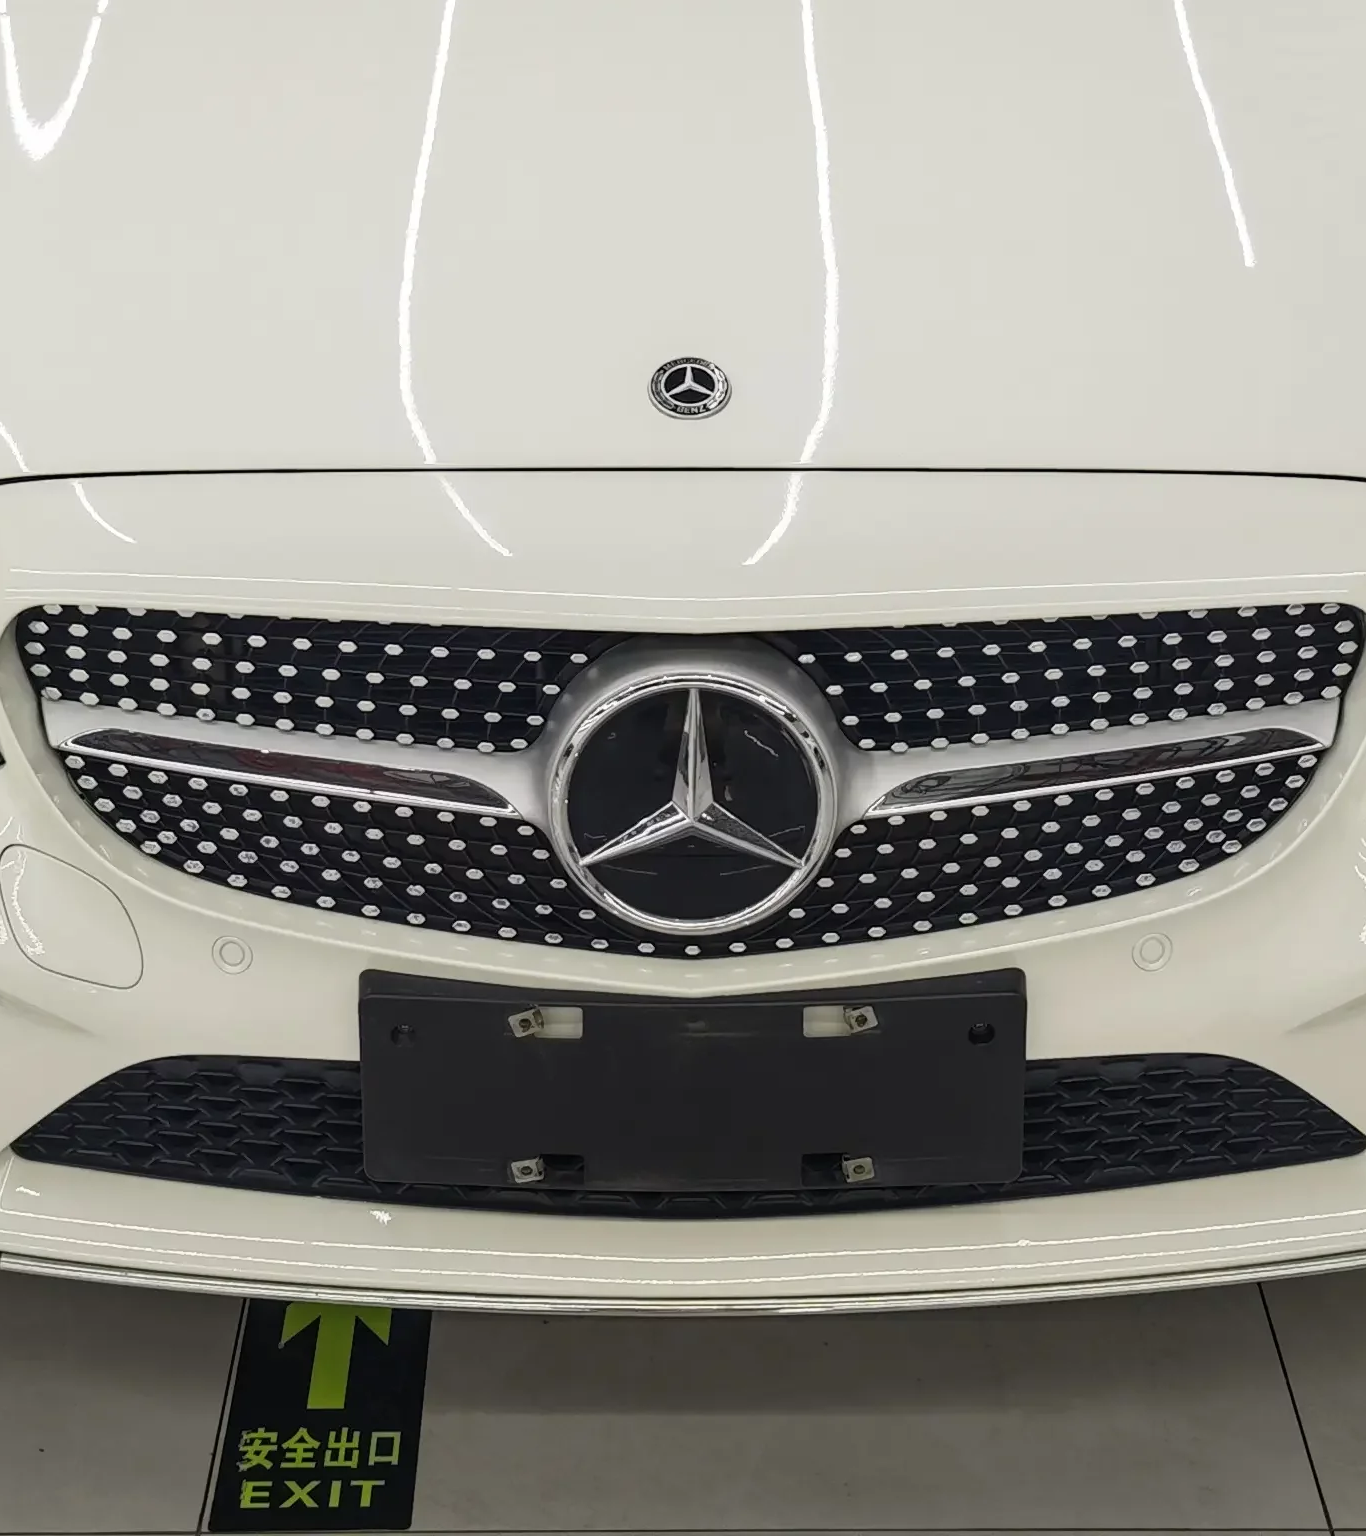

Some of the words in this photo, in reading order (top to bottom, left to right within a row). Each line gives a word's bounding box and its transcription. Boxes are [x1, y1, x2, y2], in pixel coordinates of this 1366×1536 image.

[676, 405, 707, 414] BENZ
[237, 1426, 402, 1471] 安全出口
[239, 1479, 385, 1509] EXIT
